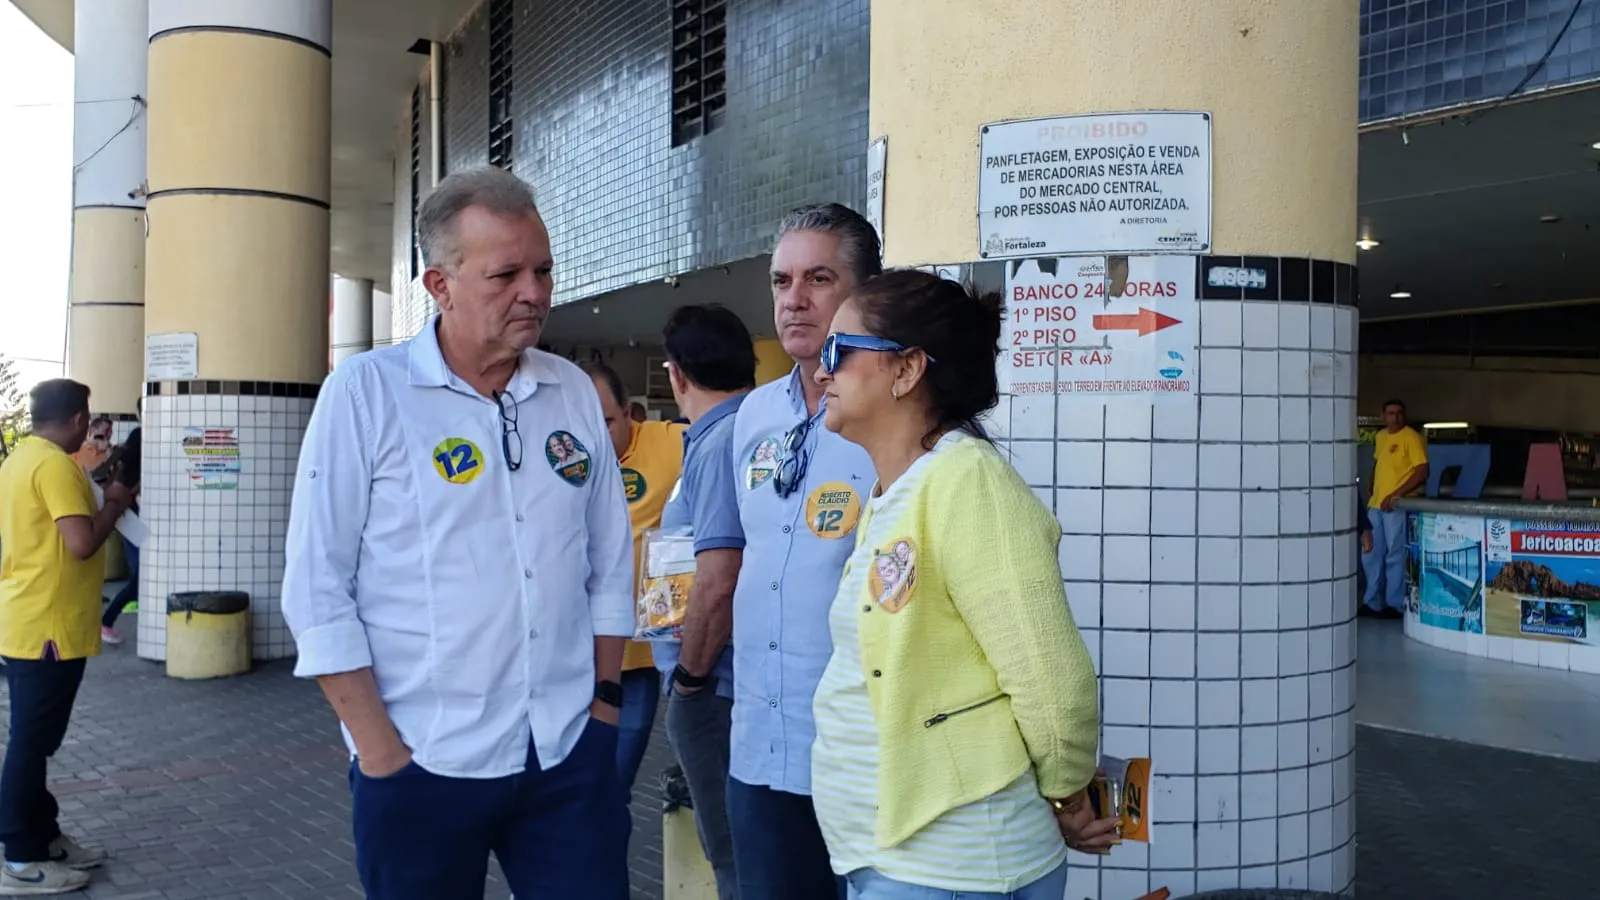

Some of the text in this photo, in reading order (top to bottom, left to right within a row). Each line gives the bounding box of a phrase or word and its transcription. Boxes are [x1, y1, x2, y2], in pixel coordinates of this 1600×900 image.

[986, 144, 1200, 168] PANFLETAGEM, EXPOSIÇÃO E VENDA
[1000, 160, 1184, 184] DE MERCADORIAS NESTA ÁREA
[1020, 180, 1162, 199] DO MERCADO CENTRAL,
[994, 197, 1189, 218] POR PESSOAS NÃO AUTORIZADA.
[1120, 216, 1168, 225] A DIRETORIA
[1004, 240, 1046, 250] Fortaleza
[1013, 281, 1177, 301] BANCO 24 ORAS
[1014, 306, 1076, 323] 1º PISO
[1013, 329, 1076, 345] 2º PISO
[1013, 351, 1073, 367] SETOR
[1131, 379, 1158, 392] ELEVADOR
[435, 443, 478, 478] 12
[624, 484, 638, 498] 2
[817, 509, 843, 532] 12
[1127, 782, 1142, 818] 12
